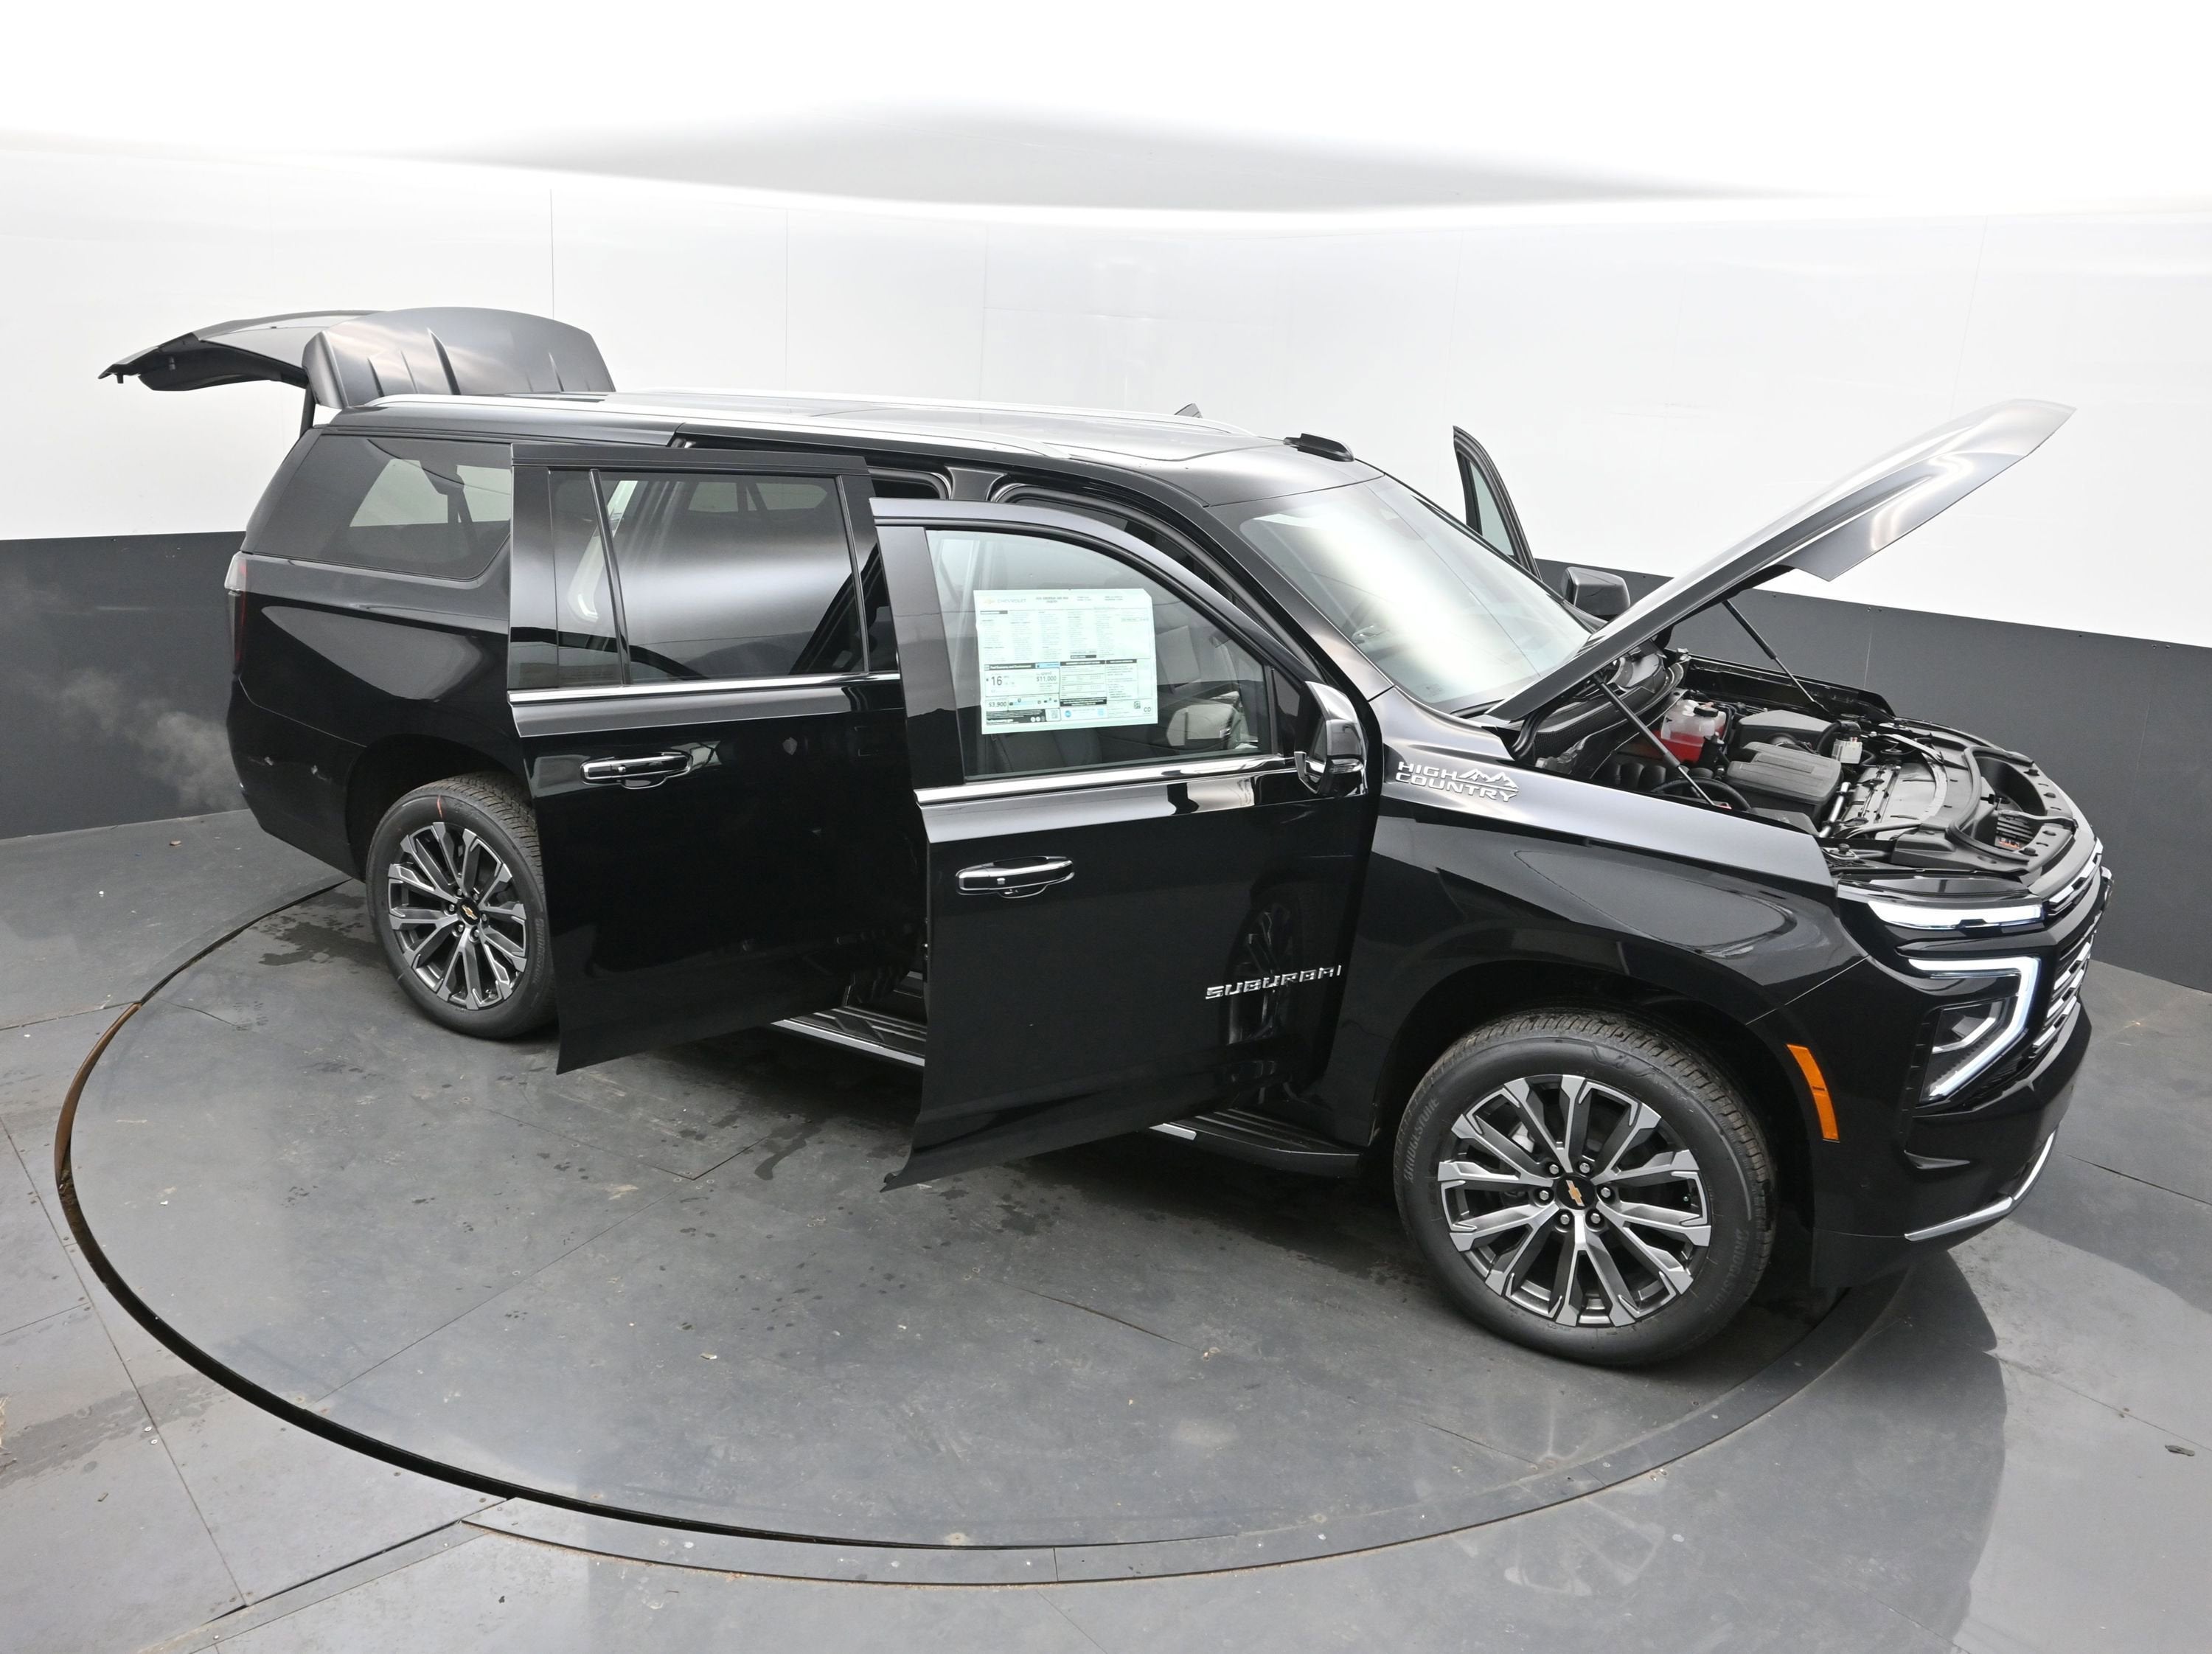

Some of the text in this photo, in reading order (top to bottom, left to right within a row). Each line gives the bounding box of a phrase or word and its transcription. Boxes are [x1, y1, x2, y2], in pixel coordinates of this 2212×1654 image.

[991, 675, 1003, 686] 16
[1398, 762, 1458, 780] HIGH
[1395, 772, 1517, 802] COUNTRY
